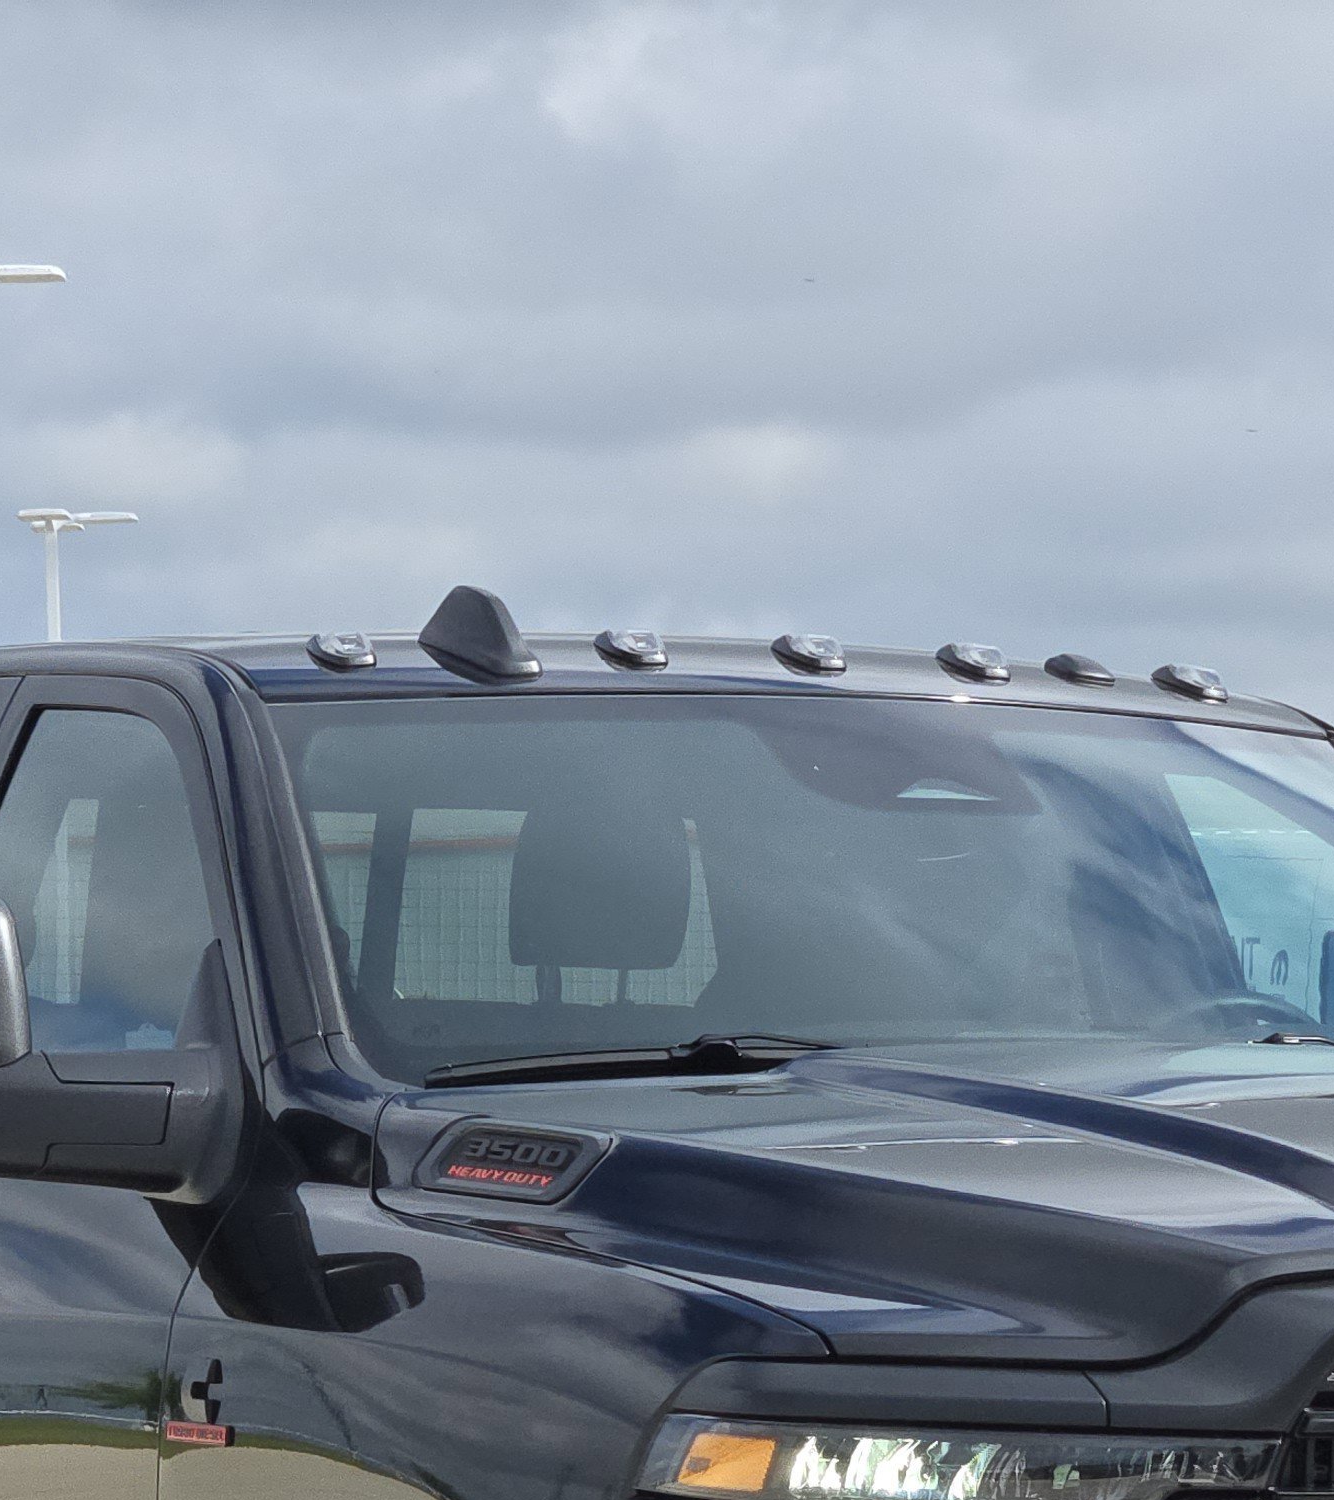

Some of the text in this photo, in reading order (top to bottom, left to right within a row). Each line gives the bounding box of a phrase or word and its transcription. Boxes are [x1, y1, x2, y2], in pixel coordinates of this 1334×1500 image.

[465, 1136, 568, 1168] 3500
[447, 1164, 553, 1188] HEAVY DUTY
